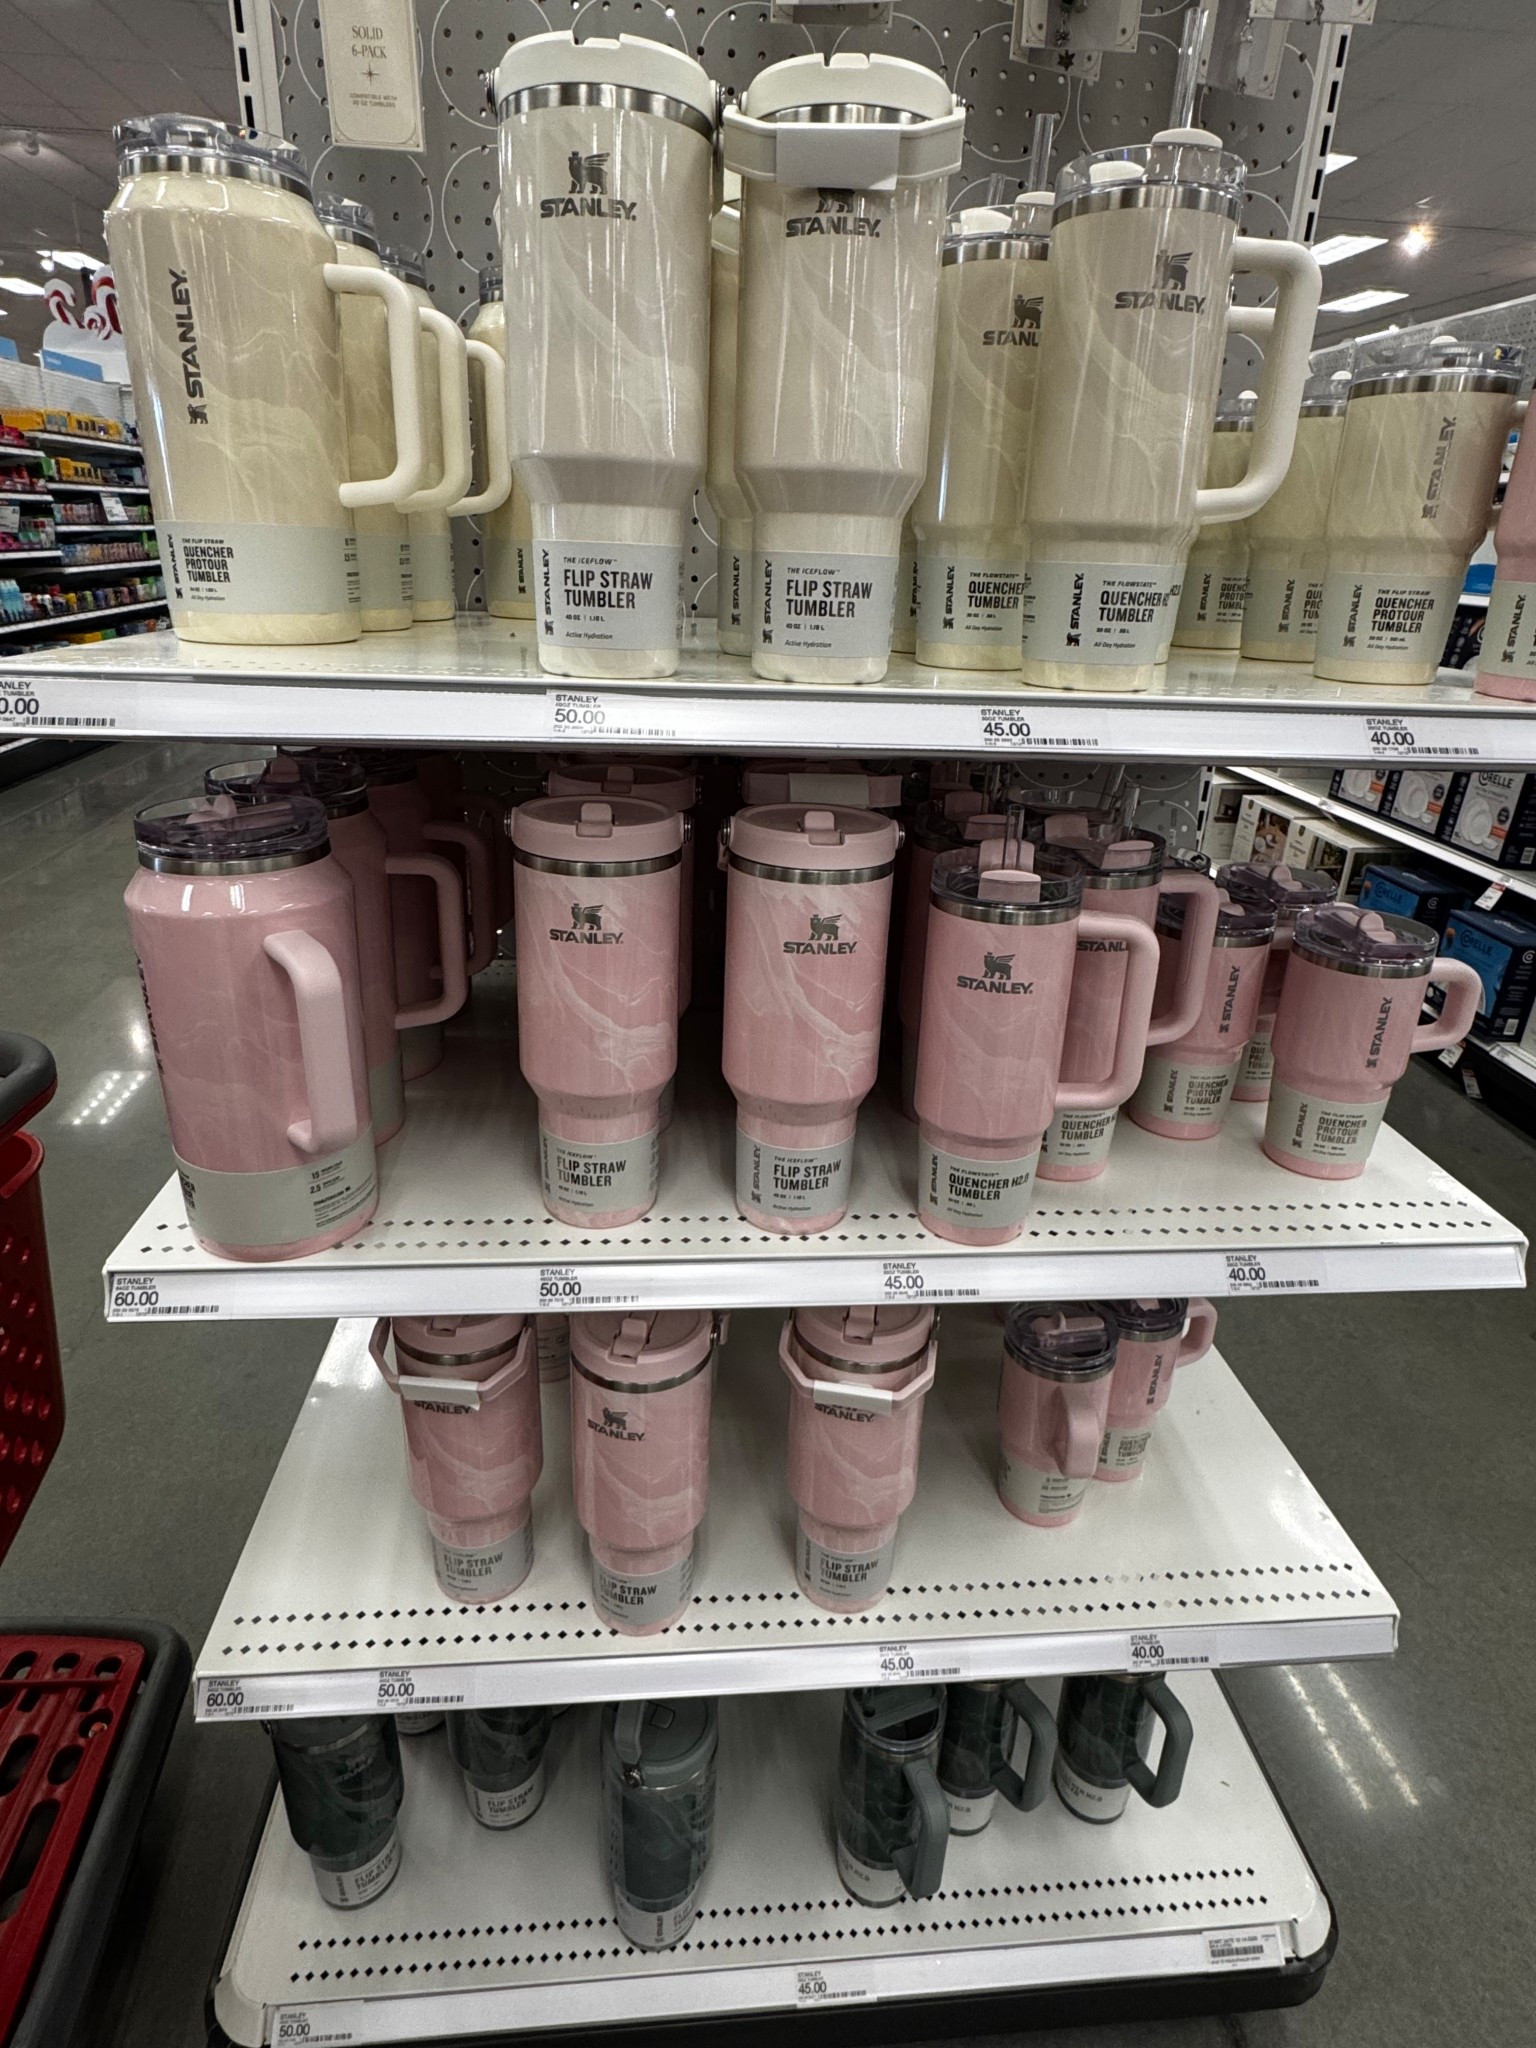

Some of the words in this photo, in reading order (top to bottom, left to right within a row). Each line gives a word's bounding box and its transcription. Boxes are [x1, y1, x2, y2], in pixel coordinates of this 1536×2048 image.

[351, 25, 383, 40] SOLID
[351, 44, 387, 59] 6-PACK
[540, 198, 637, 221] STANLEY
[786, 215, 881, 239] STANLEY
[1115, 291, 1206, 315] STANLEY
[169, 268, 204, 399] STANLEY
[983, 330, 1039, 347] STANL
[1427, 417, 1457, 507] STANLEY
[167, 534, 180, 584] STANLEY
[183, 546, 234, 558] QUENCHER
[185, 558, 228, 570] PROTOUR
[517, 548, 525, 583] STANLEY
[187, 570, 231, 583] TUMBLER
[542, 549, 553, 616] STANLEY
[564, 569, 595, 587] FLIP
[600, 570, 653, 590] STRAW
[732, 556, 740, 609] STANLEY
[764, 560, 773, 625] STANLEY
[786, 579, 818, 597] FLIP
[822, 580, 873, 599] STRAW
[945, 566, 955, 614] STANLEY
[1200, 574, 1211, 610] STANLEY
[1221, 583, 1246, 592] QUENC
[564, 589, 636, 610] TUMBLER
[967, 596, 1020, 609] TUMBLER
[1070, 573, 1084, 630] STANLEY
[1100, 590, 1161, 607] QUENCHER
[1220, 592, 1244, 601] PROTO
[1282, 580, 1295, 620] STANLEY
[1375, 597, 1435, 610] QUENCHER
[786, 598, 856, 618] TUMBLER
[1219, 601, 1243, 609] TUMBL
[1348, 584, 1363, 632] STANLEY
[1099, 607, 1154, 622] TUMBLER
[1373, 609, 1425, 621] PROTOUR
[1507, 594, 1526, 647] STANLEY
[1371, 620, 1422, 633] TUMBLER
[803, 640, 832, 648] Hydration
[0, 681, 31, 690] ANLEY
[0, 697, 39, 715] 0.00
[556, 694, 598, 703] STANLEY
[555, 708, 605, 724] 50.00
[1366, 718, 1403, 726] STANLEY
[983, 722, 1031, 737] 45.00
[1371, 731, 1415, 746] 40.00
[549, 928, 624, 945] STANLEY
[783, 941, 857, 956] STANLEY
[1077, 939, 1126, 953] STANL
[957, 975, 1034, 995] STANLEY
[1222, 965, 1240, 1016] STANLEY
[1369, 997, 1393, 1055] STANLEY
[1167, 1069, 1178, 1103] STANLEY
[1186, 1096, 1221, 1105] TUMBLER
[1062, 1116, 1110, 1130] QUENCHER
[1295, 1103, 1308, 1138] STANLEY
[1319, 1117, 1367, 1128] QUENCHER
[1061, 1128, 1104, 1140] TUMBLER
[1317, 1125, 1360, 1136] PROTOUR
[1316, 1133, 1357, 1144] TUMBLER
[557, 1156, 580, 1172] FLIP
[584, 1160, 627, 1174] STRAW
[753, 1144, 761, 1190] STANLEY
[774, 1164, 800, 1178] FLIP
[804, 1160, 841, 1178] STRAW
[311, 1171, 320, 1180] 15
[558, 1169, 612, 1187] TUMBLER
[773, 1176, 829, 1190] TUMBLER
[949, 1173, 1009, 1189] QUENCHER
[1011, 1172, 1029, 1187] H2.0
[310, 1184, 321, 1194] 2.5
[949, 1184, 1000, 1200] TUMBLER
[885, 1275, 924, 1289] 45.00
[1229, 1268, 1265, 1281] 40.00
[540, 1282, 581, 1296] 50.00
[115, 1291, 158, 1306] 60.00
[1151, 1354, 1163, 1393] STANLEY
[413, 1400, 471, 1414] STANLEY
[814, 1403, 875, 1422] STANLEY
[587, 1418, 645, 1441] STANLEY
[466, 1552, 503, 1568] STRAW
[845, 1559, 878, 1573] STRAW
[821, 1568, 867, 1582] TUMBLER
[620, 1584, 657, 1596] STRAW
[1132, 1646, 1164, 1659] 40.00
[880, 1657, 914, 1671] 45.00
[378, 1683, 414, 1697] 50.00
[207, 1692, 244, 1706] 60.00
[799, 1981, 827, 1995] 45.00
[279, 2024, 310, 2037] 50.00
